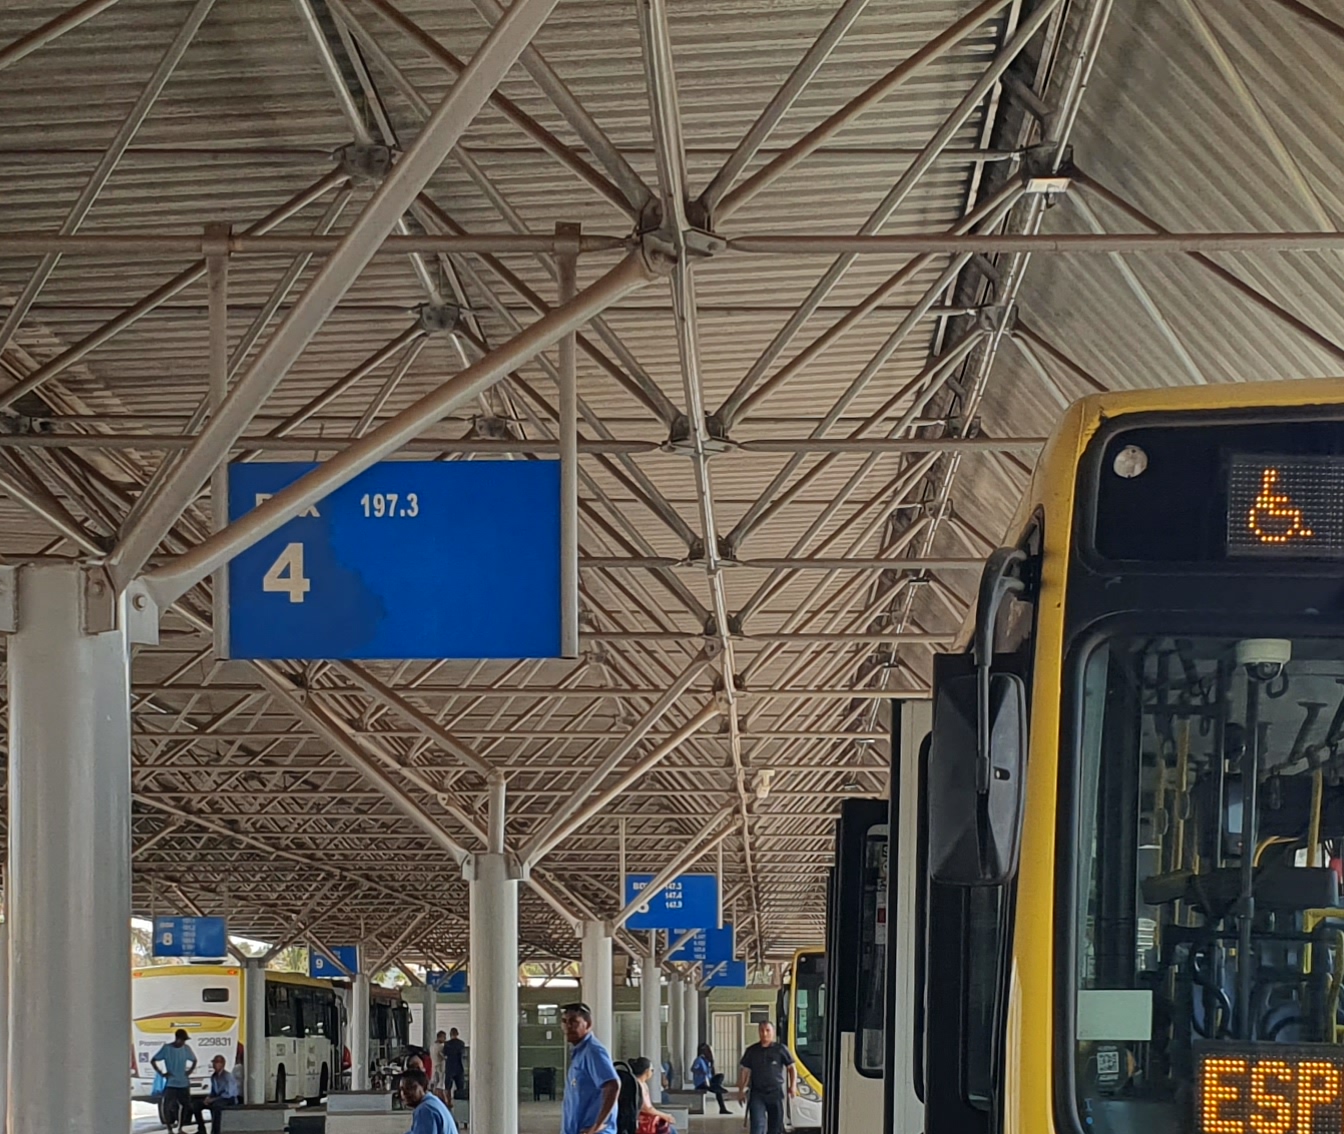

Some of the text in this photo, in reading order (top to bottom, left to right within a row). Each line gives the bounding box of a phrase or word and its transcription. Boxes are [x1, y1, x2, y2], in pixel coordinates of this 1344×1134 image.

[360, 493, 419, 517] 197.3
[263, 542, 310, 603] 4
[162, 932, 173, 946] 8
[315, 958, 324, 969] 9
[197, 1037, 232, 1047] 229831
